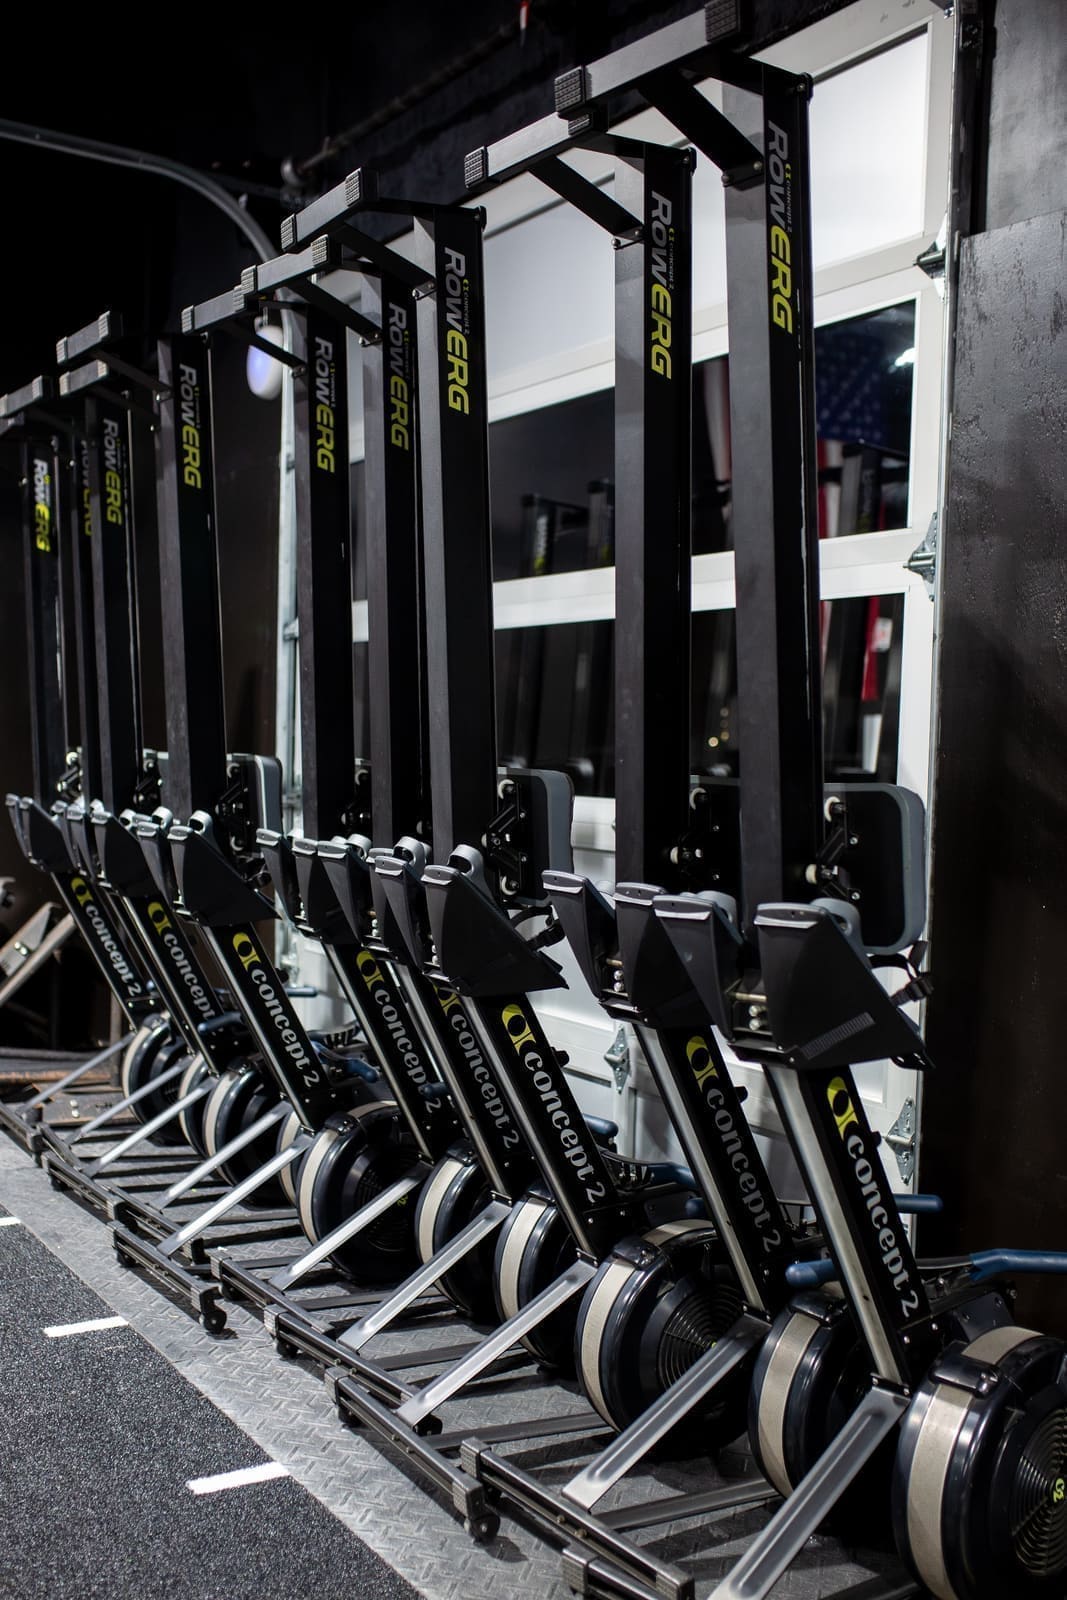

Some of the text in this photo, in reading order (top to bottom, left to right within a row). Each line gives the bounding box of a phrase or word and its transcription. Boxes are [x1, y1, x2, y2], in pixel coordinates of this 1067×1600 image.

[85, 904, 142, 997] concept 2
[251, 968, 320, 1088] concept 2
[451, 1013, 519, 1149] concept 2
[424, 1097, 442, 1114] 2
[524, 1051, 606, 1204] concept 2
[707, 1088, 782, 1253] concept 2
[847, 1134, 919, 1319] concept 2
